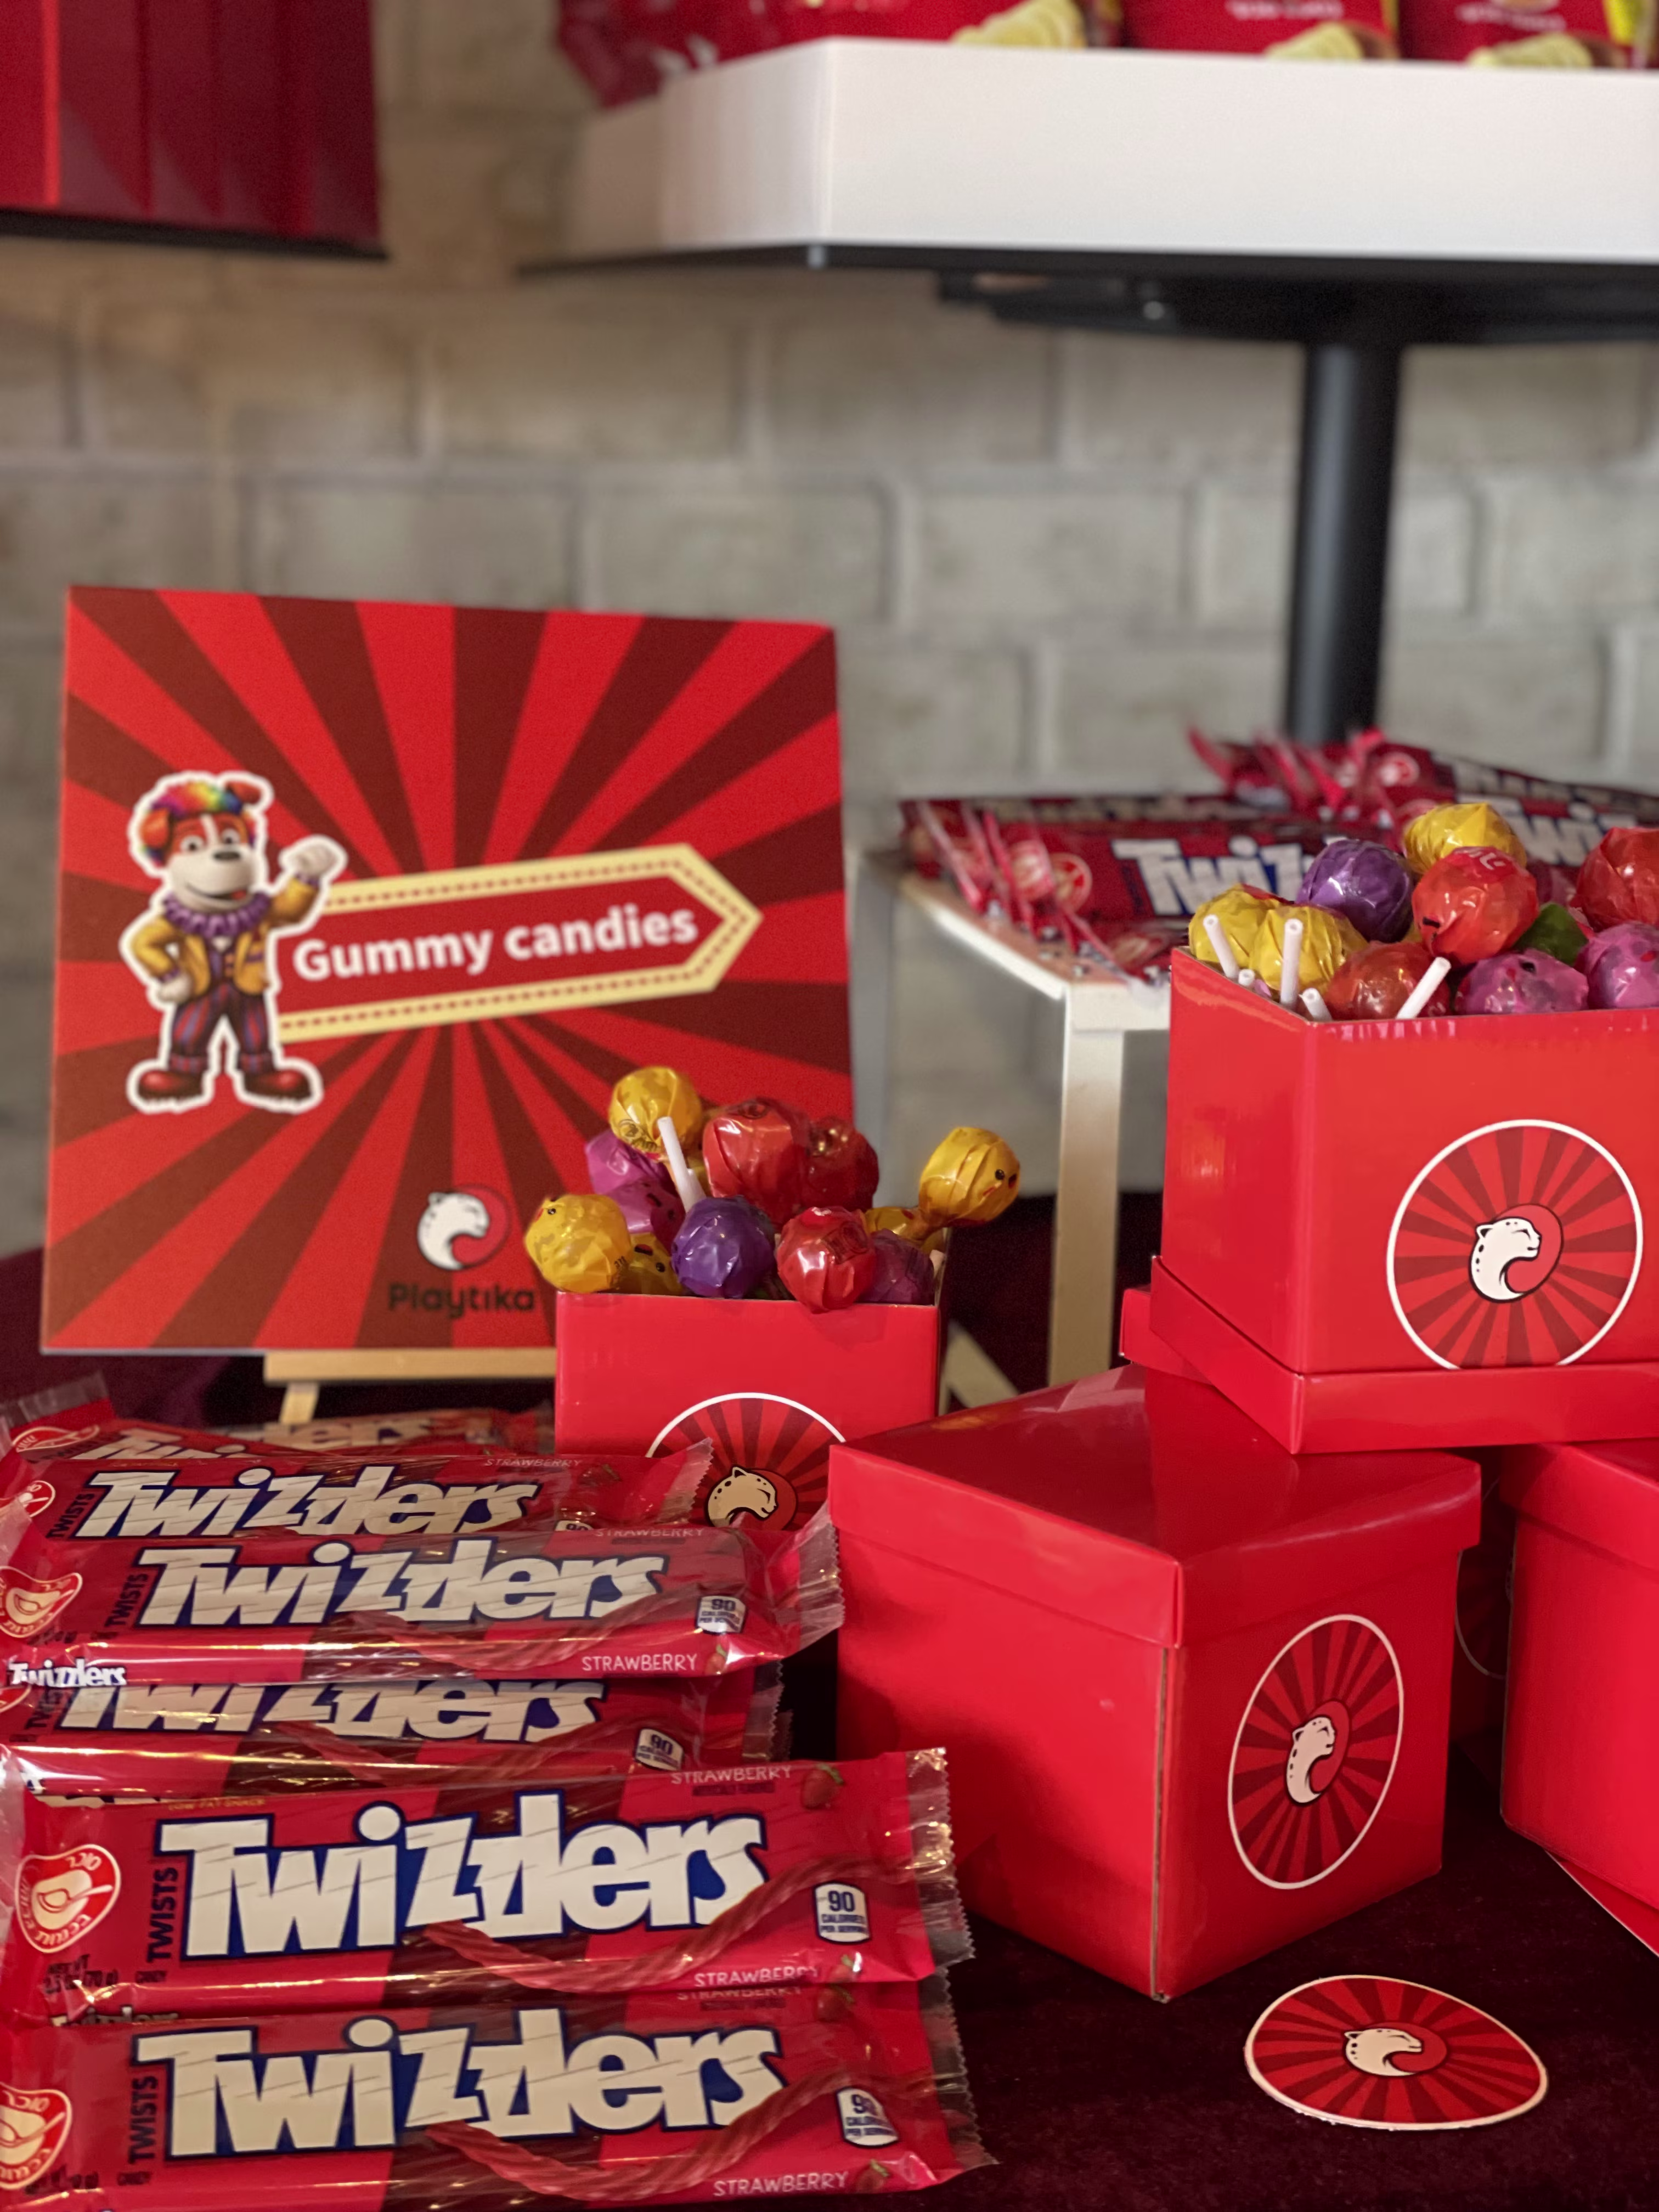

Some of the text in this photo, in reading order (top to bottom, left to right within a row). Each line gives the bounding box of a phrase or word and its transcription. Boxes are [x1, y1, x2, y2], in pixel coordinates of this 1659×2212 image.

[293, 904, 698, 981] Gummy candies
[388, 1282, 535, 1319] Playtika
[484, 1458, 583, 1468] STRAWBERRY
[45, 1493, 95, 1539] TWISTS
[74, 1466, 540, 1537] Twizzlers
[104, 1573, 149, 1627] TWISTS
[138, 1538, 665, 1625] Twizzlers
[712, 1599, 736, 1611] 90
[582, 1653, 697, 1673] STRAWBERRY
[651, 1734, 673, 1755] 90
[670, 1764, 792, 1784] STRAWBERRY
[159, 1794, 766, 1957] Twizzlers
[146, 1866, 179, 1963] TWISTS
[828, 1890, 855, 1912] 90
[137, 2009, 785, 2156] Twizzlers
[127, 2075, 159, 2165] TWISTS
[714, 2171, 848, 2198] STRAWBERRY
